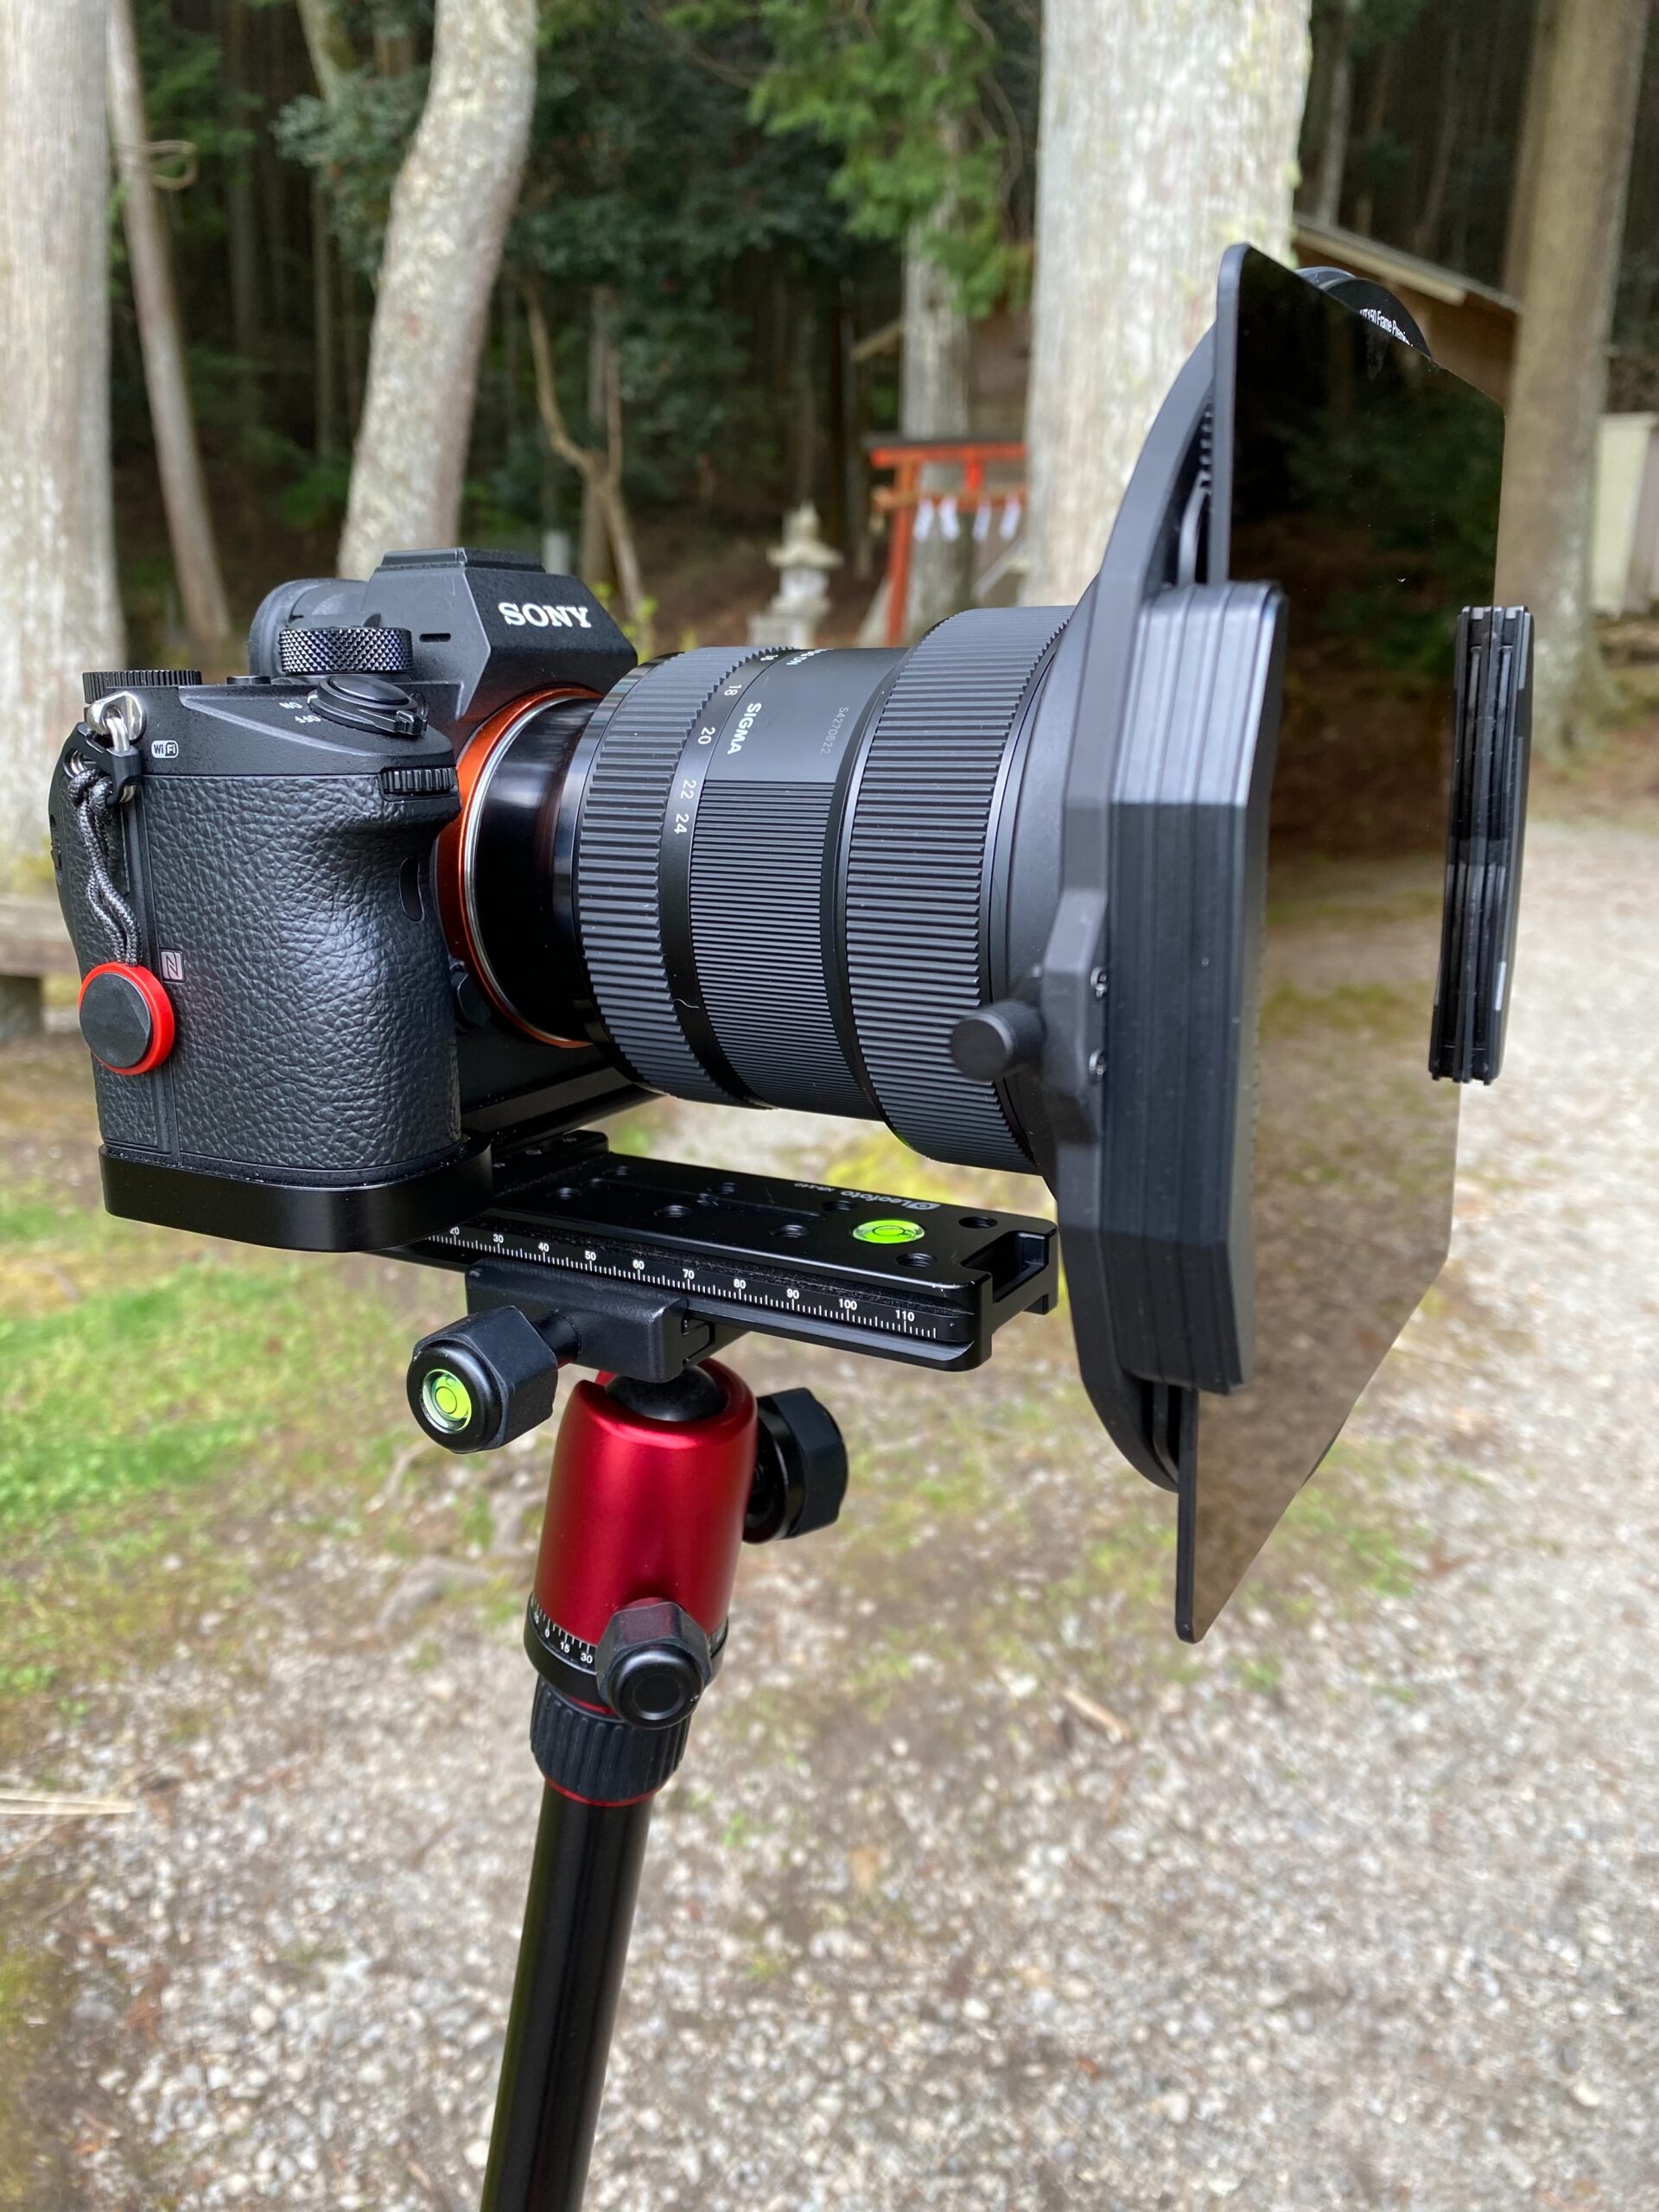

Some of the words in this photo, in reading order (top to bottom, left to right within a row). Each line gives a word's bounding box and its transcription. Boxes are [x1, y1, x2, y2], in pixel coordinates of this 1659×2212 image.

[1376, 310, 1393, 333] Frame
[499, 602, 592, 628] SONY
[724, 684, 742, 696] 18
[294, 715, 321, 724] OFF
[727, 702, 762, 755] SIGMA
[697, 727, 715, 745] 20
[680, 779, 697, 799] 22
[674, 813, 690, 835] 24
[841, 1191, 912, 1208] Leofoto
[493, 1233, 504, 1243] 30
[537, 1243, 550, 1253] 40
[585, 1250, 596, 1262] 50
[632, 1259, 645, 1270] 60
[683, 1268, 695, 1280] 70
[734, 1279, 747, 1290] 80
[786, 1288, 799, 1300] 90
[838, 1298, 858, 1311] 100
[895, 1309, 916, 1323] 110
[560, 1642, 570, 1654] 15
[580, 1652, 593, 1664] 30
